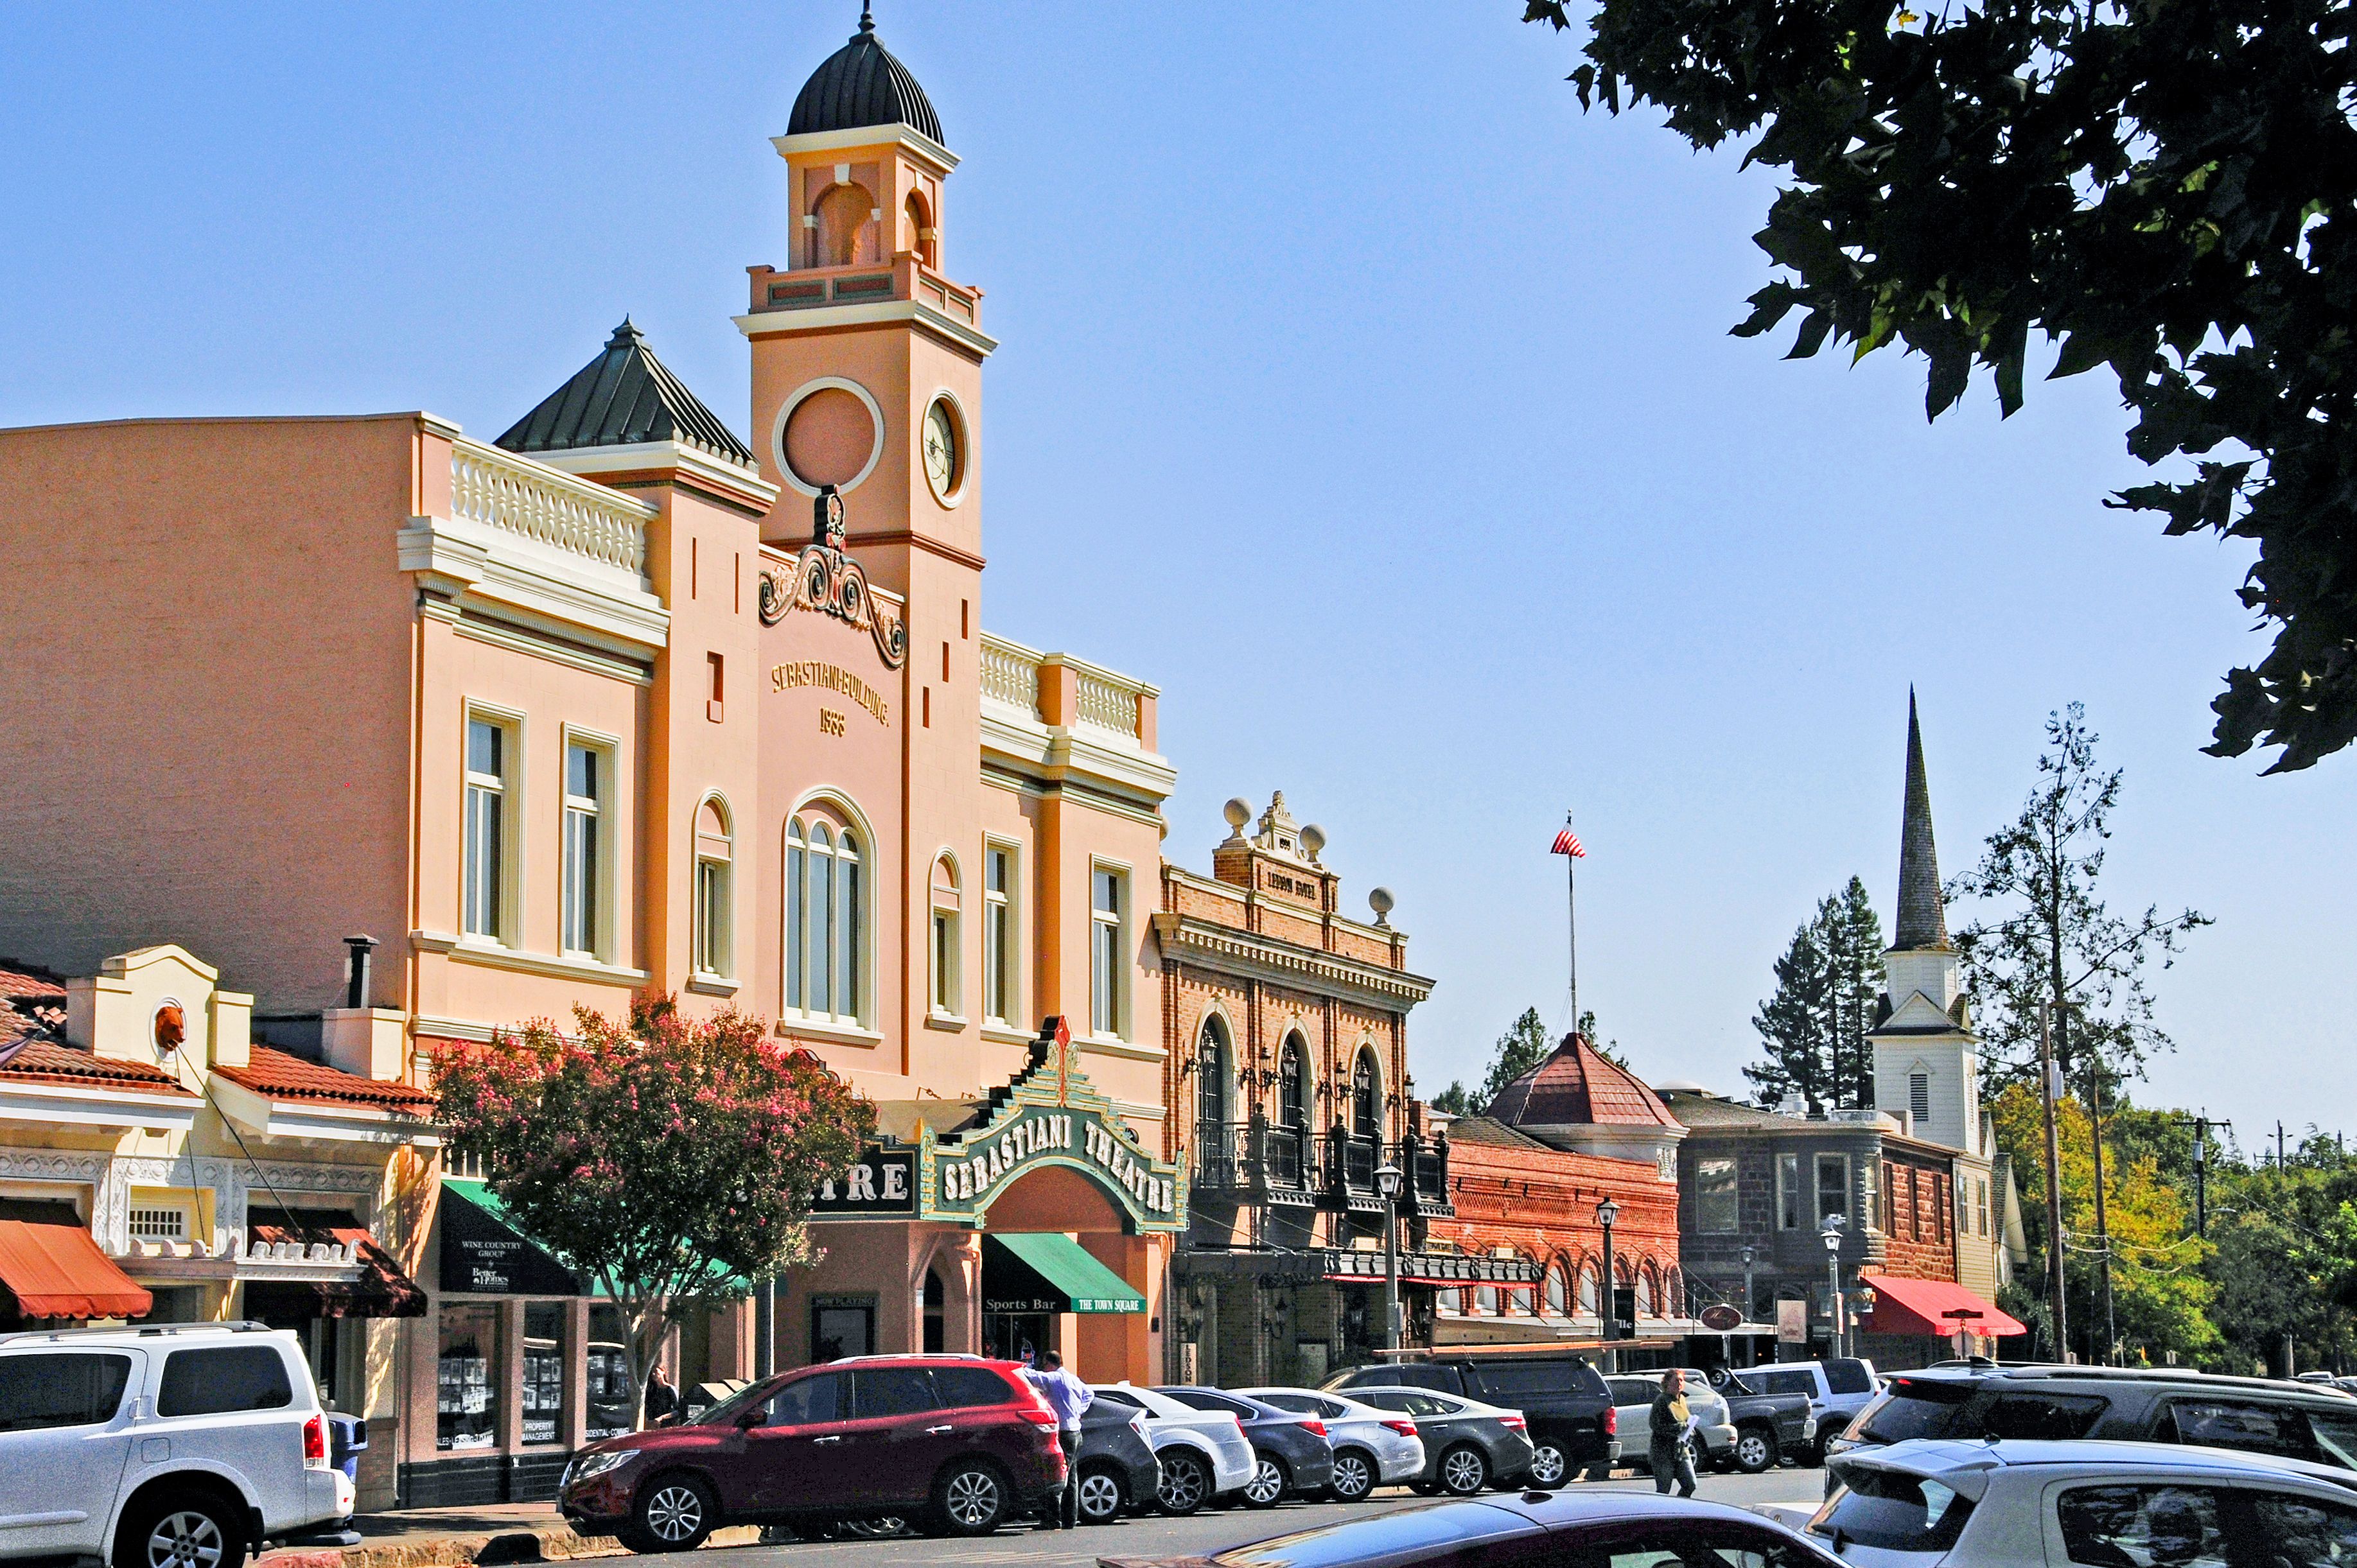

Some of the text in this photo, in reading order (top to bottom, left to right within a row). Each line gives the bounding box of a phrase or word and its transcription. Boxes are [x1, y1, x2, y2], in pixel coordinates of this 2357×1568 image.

[945, 1115, 1173, 1212] SEBASTIANI THEATRE
[478, 1250, 505, 1258] GROUP
[986, 1299, 1056, 1311] Sports Bar
[1079, 1300, 1139, 1312] THE TOWN SQUARE
